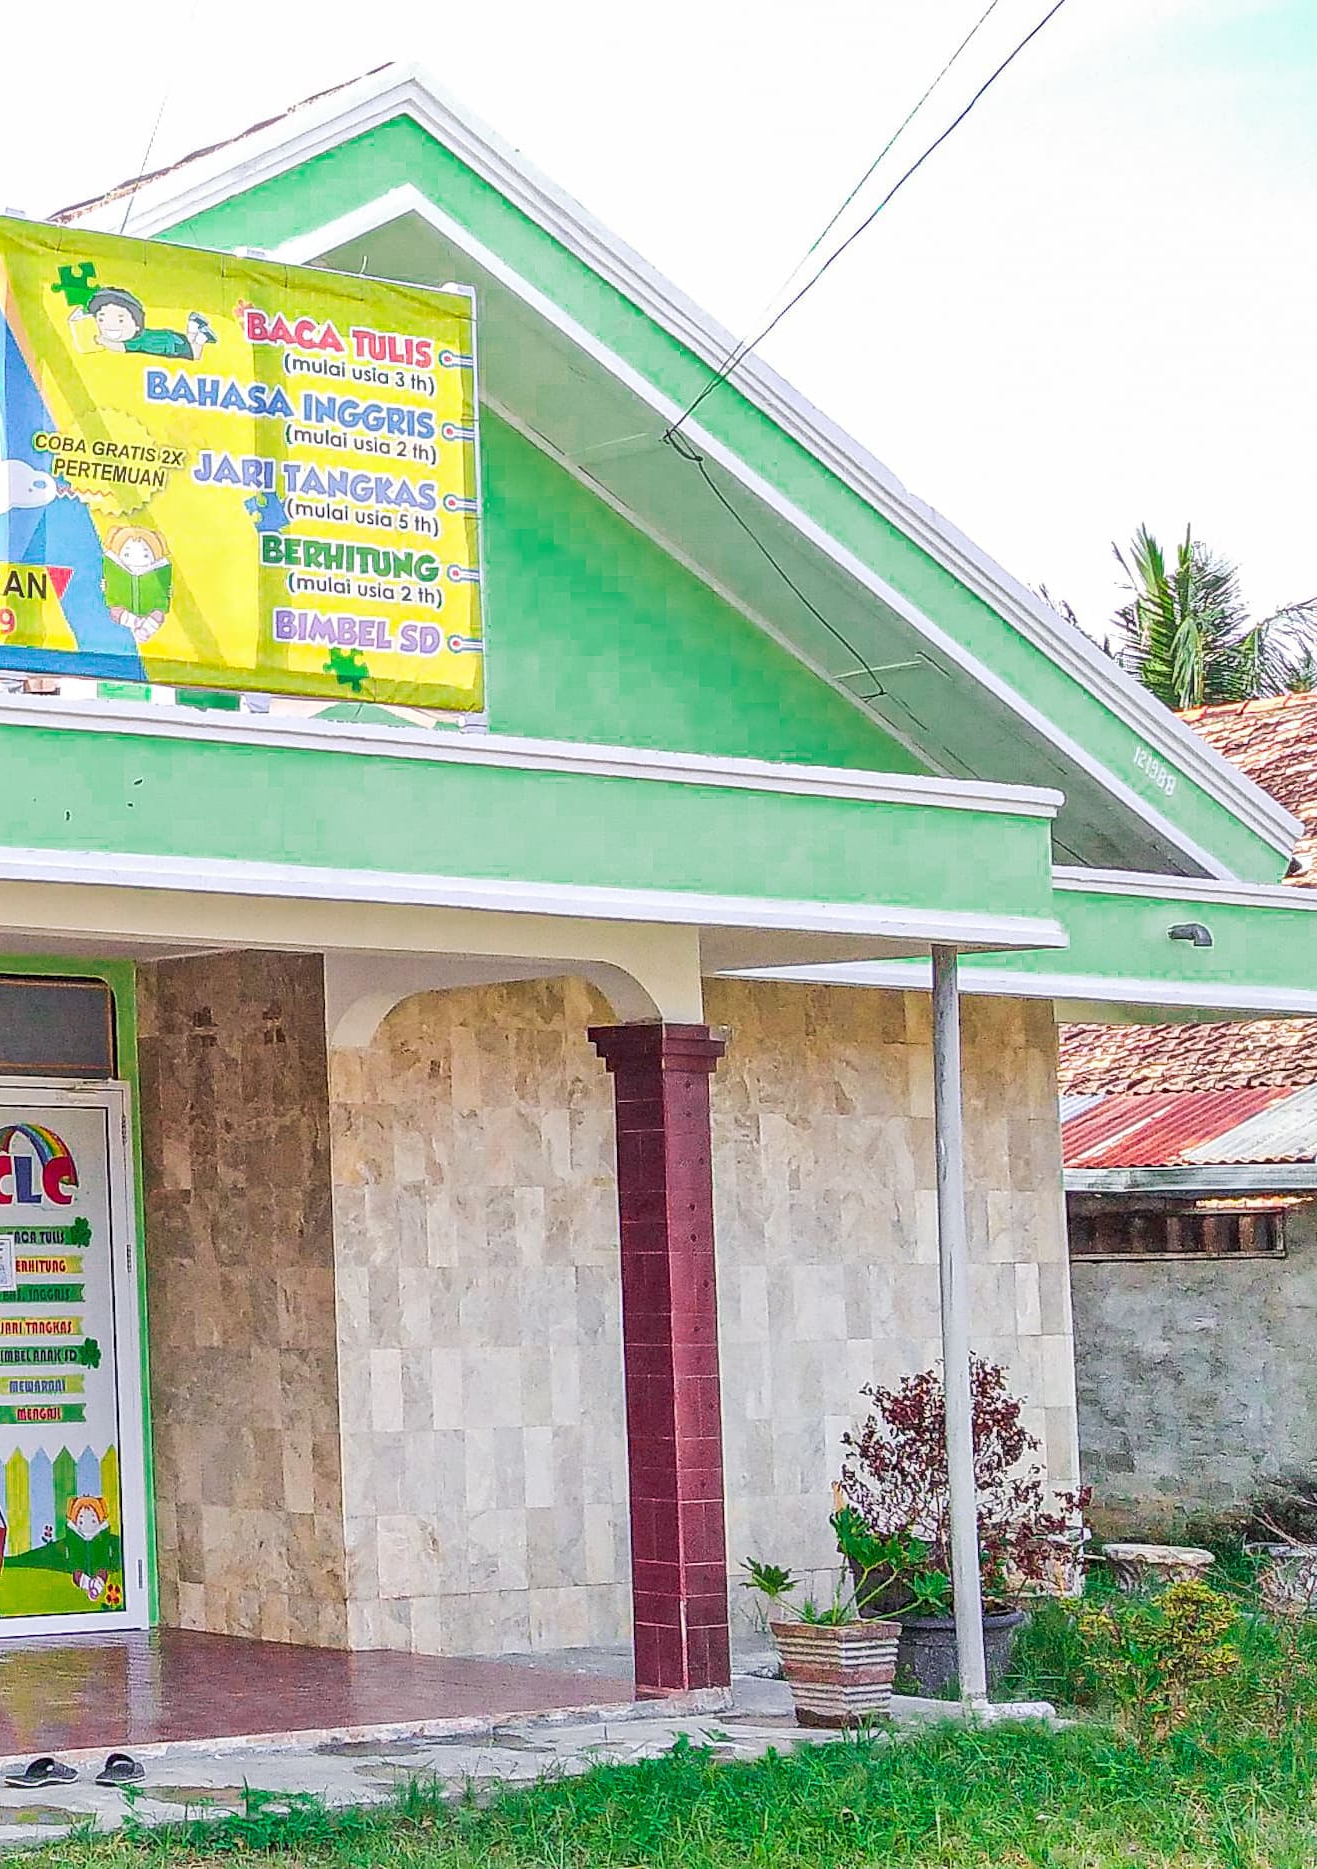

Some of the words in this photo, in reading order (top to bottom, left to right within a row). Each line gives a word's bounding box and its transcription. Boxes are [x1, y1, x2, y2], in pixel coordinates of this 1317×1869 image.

[246, 311, 345, 352] BACA
[352, 329, 434, 369] TULIS
[284, 353, 346, 378] (mulai
[352, 367, 389, 385] usia
[395, 371, 405, 388] 3
[411, 374, 435, 396] th)
[146, 370, 295, 418] BAHASA
[303, 393, 436, 440] INGGRIS
[34, 434, 87, 455] COBA
[91, 441, 155, 463] GRATIS
[161, 449, 184, 467] 2X
[285, 423, 348, 449] (mulai
[353, 437, 391, 455] usia
[396, 441, 407, 457] 2
[412, 443, 437, 465] th)
[53, 459, 165, 488] PERTEMUAN
[193, 453, 276, 490] JARI
[282, 463, 436, 510] TANGKAS
[286, 498, 349, 523] (mulai
[355, 509, 393, 528] usia
[398, 513, 409, 530] 5
[414, 514, 440, 537] th)
[261, 534, 439, 582] BERHITUNG
[287, 569, 351, 595] (mulai
[357, 579, 395, 601] usia
[400, 585, 412, 603] 2
[418, 586, 444, 609] th)
[275, 610, 393, 650] BIMBEL
[399, 626, 441, 654] SD
[15, 1260, 66, 1273] ERHITUNG
[0, 1321, 22, 1334] JARI
[25, 1321, 72, 1334] TANGKAS
